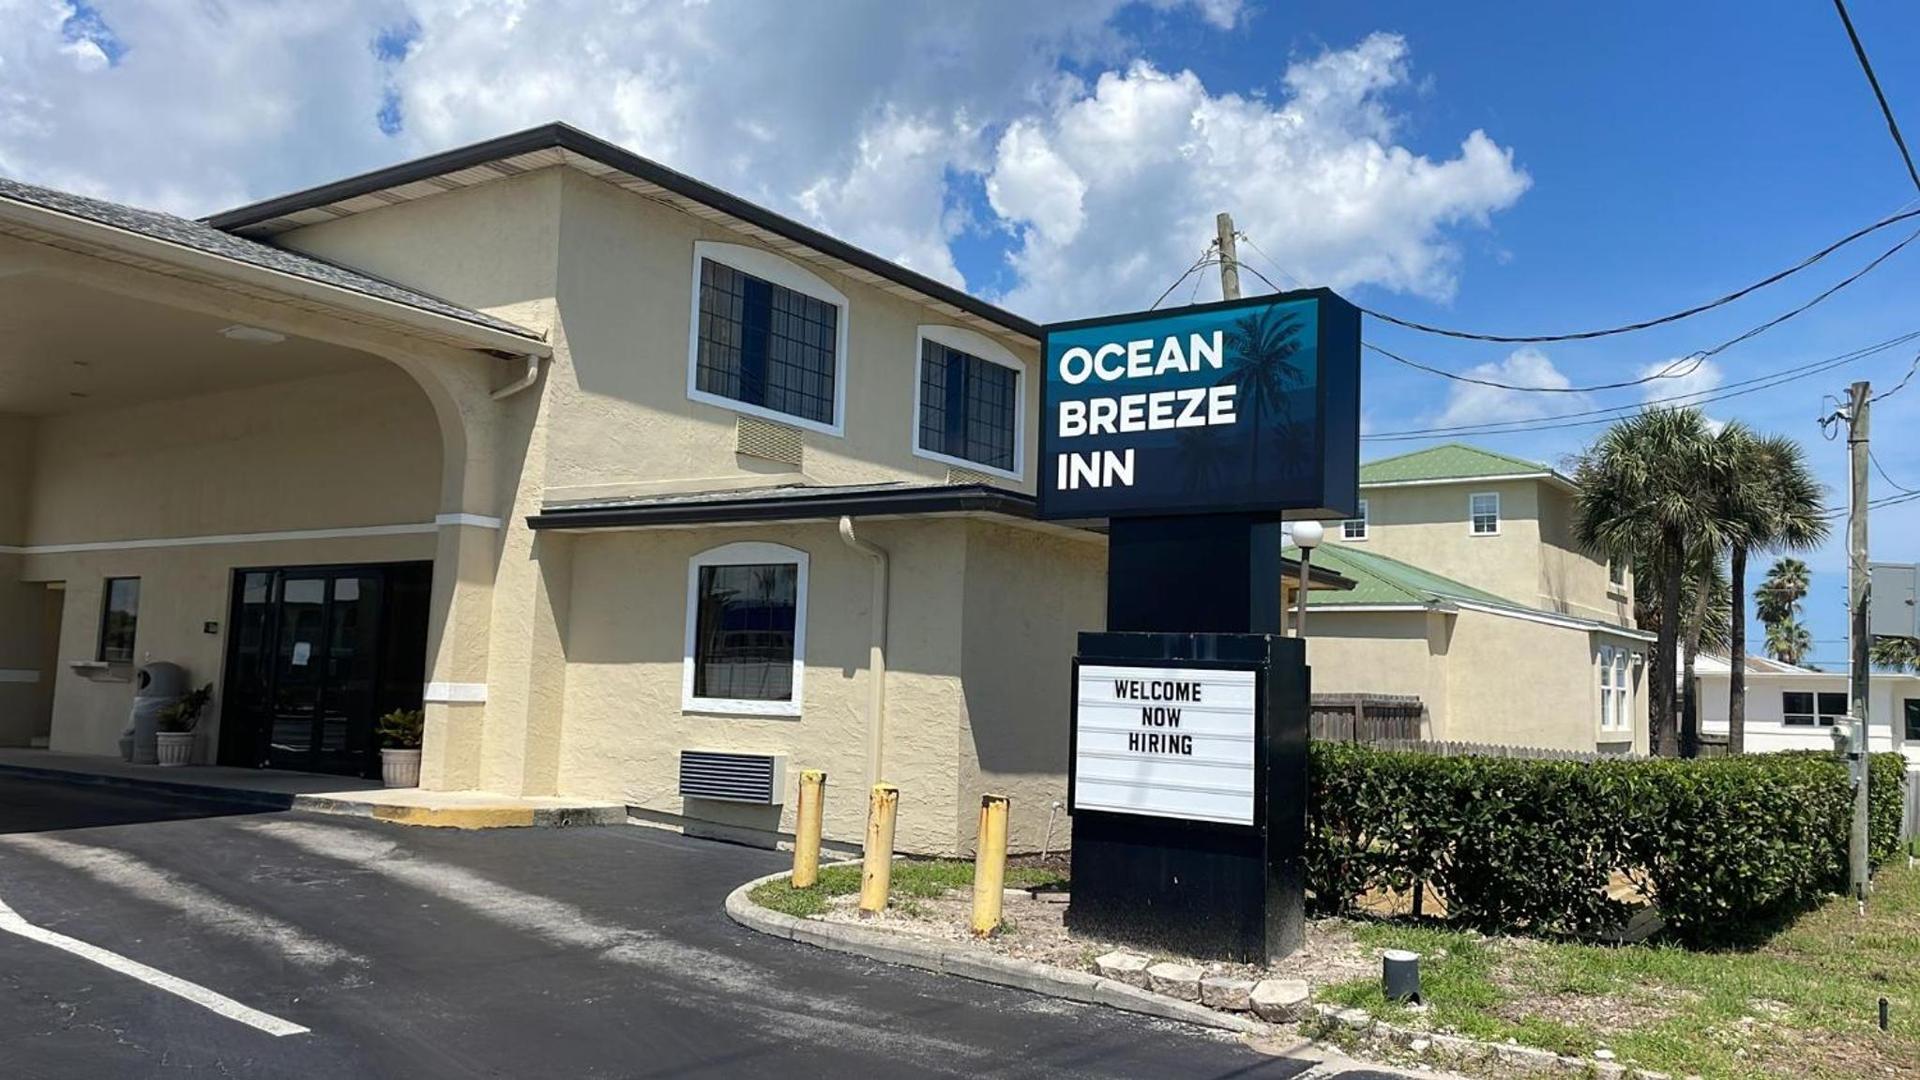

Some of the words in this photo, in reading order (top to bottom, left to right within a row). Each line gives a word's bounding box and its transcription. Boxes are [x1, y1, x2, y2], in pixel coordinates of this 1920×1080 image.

[1059, 330, 1223, 385] OCEAN
[1059, 385, 1237, 438] BREEZE
[1057, 448, 1134, 490] INN
[1115, 679, 1201, 702] WELCOME
[1142, 707, 1181, 727] NOW
[1129, 732, 1192, 755] HIRING
